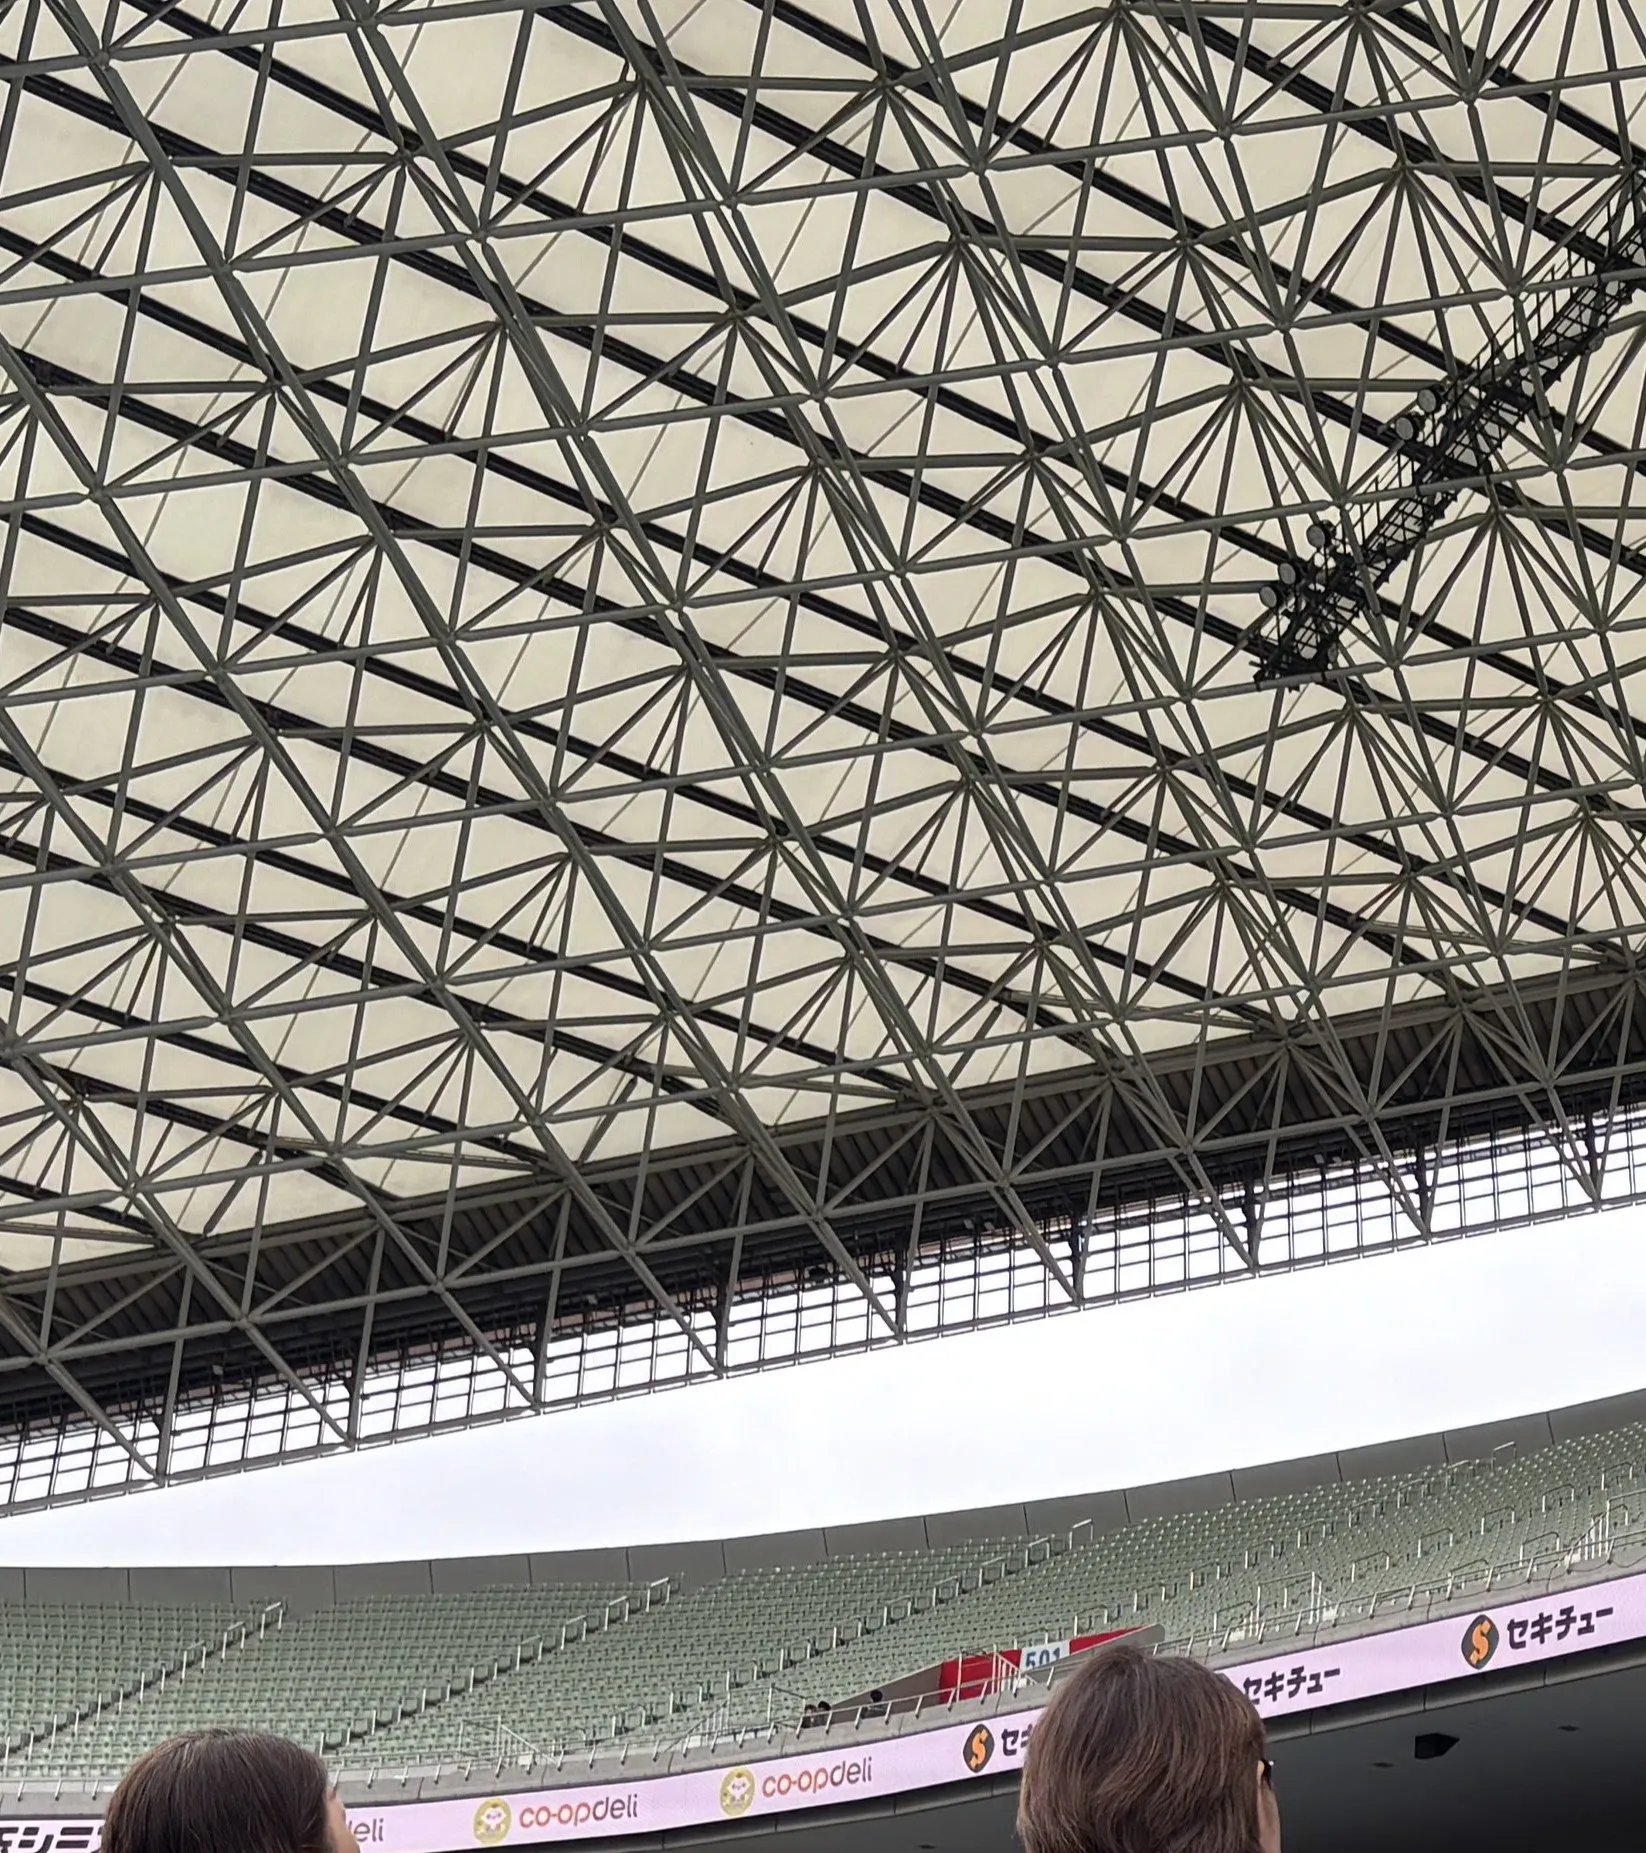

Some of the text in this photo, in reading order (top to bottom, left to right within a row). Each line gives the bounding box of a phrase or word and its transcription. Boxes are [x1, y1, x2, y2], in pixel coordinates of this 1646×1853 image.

[1507, 1605, 1614, 1650] セキチュー
[763, 1757, 872, 1798] co-opdeli
[519, 1794, 638, 1828] co-opdeli
